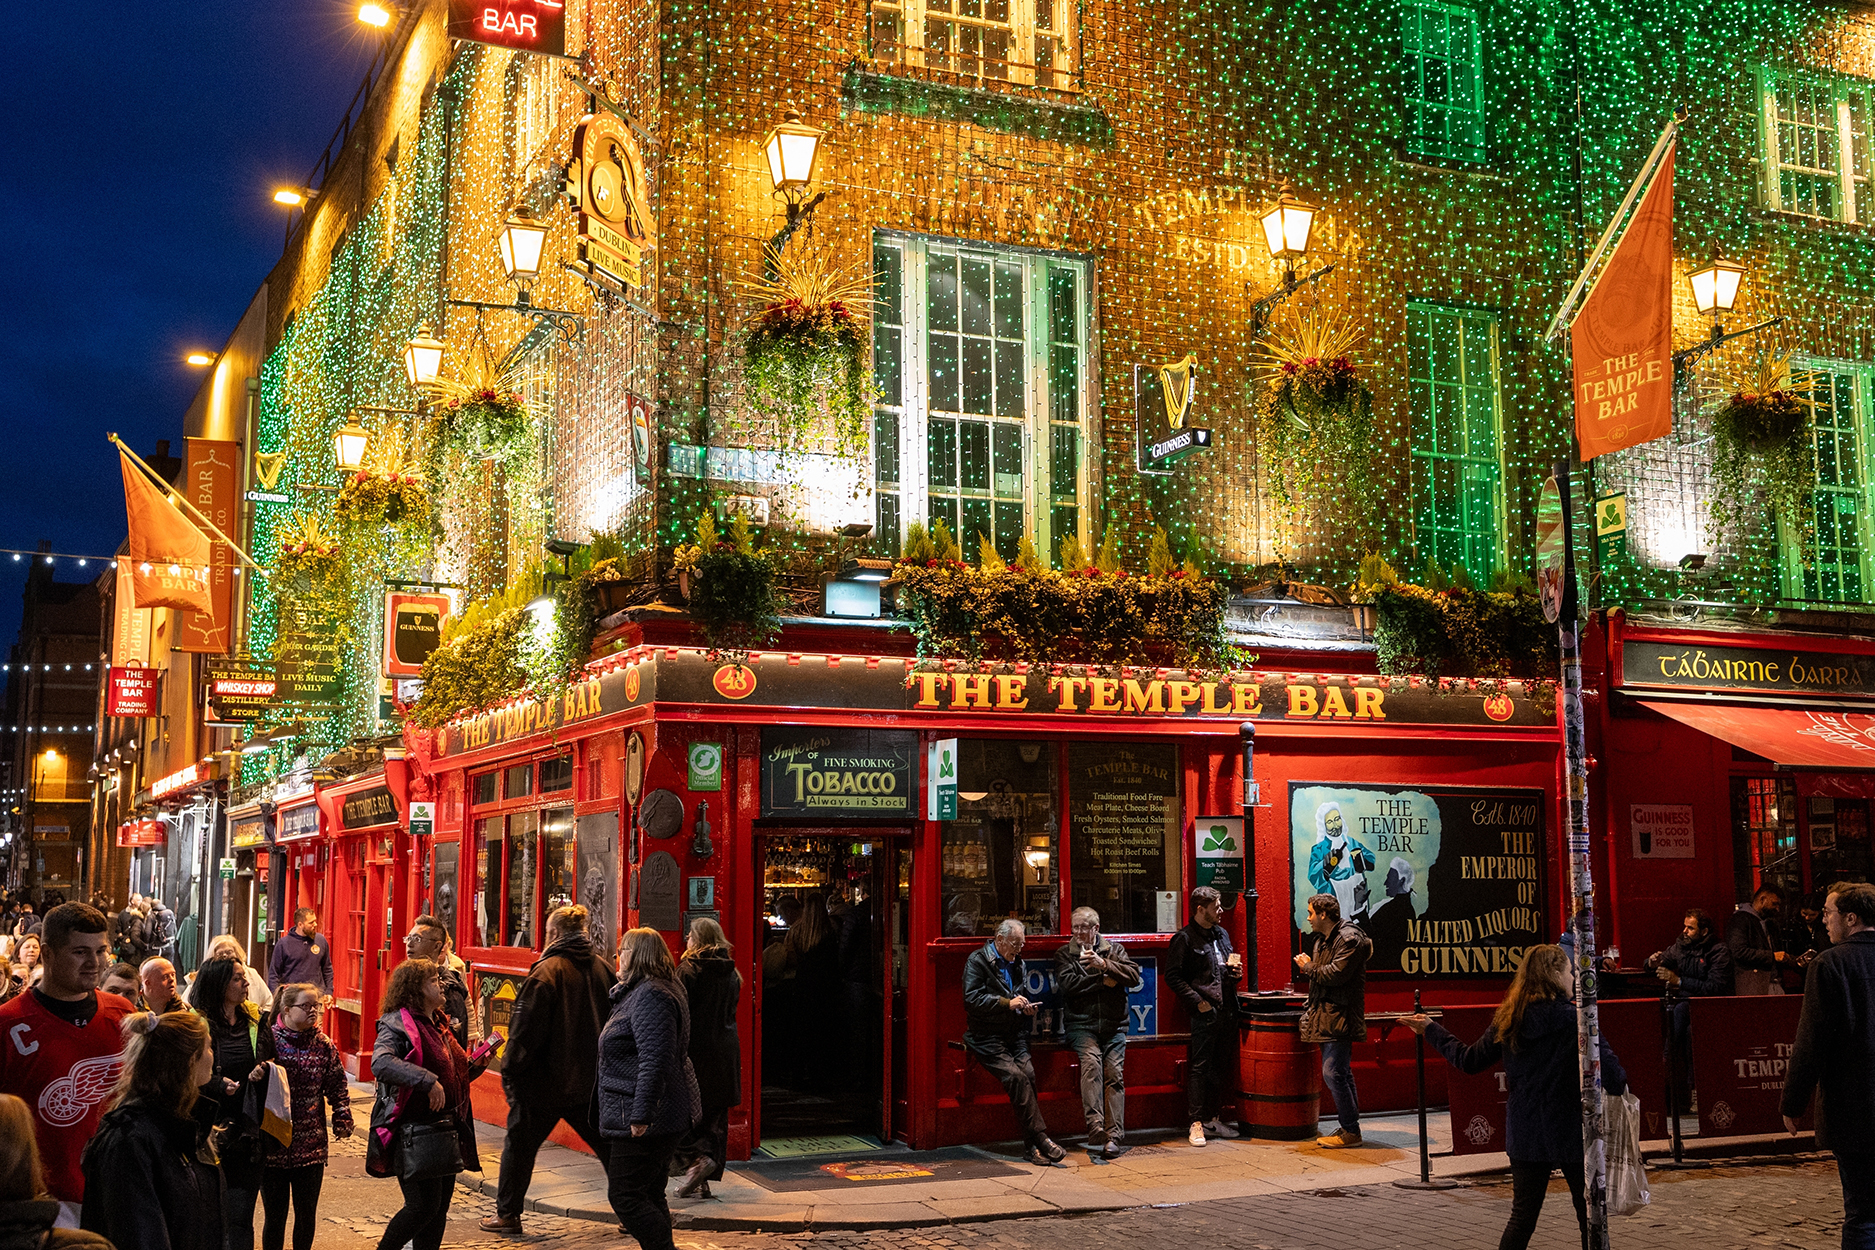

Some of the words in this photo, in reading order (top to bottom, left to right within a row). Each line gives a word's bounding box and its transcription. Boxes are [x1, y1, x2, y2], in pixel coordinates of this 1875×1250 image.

[483, 8, 537, 38] BAR
[598, 226, 631, 256] DUBLIN
[592, 246, 610, 269] LIVE
[612, 257, 637, 283] MUSIC
[1603, 353, 1639, 375] THE
[1581, 360, 1663, 404] TEMPLE
[1598, 391, 1638, 420] BAR
[1152, 432, 1191, 459] GUINNESS
[199, 470, 213, 505] BAR
[248, 490, 289, 503] GUINNESS
[217, 507, 226, 527] CO.
[161, 577, 198, 592] BAR
[400, 624, 435, 632] GUINNESS
[125, 670, 143, 678] THE
[211, 671, 228, 679] THE
[230, 672, 264, 680] TEMPLE
[282, 673, 304, 681] LIVE
[305, 674, 337, 682] MUSIC
[720, 668, 747, 691] 48
[115, 679, 153, 688] TEMPLE
[122, 688, 143, 697] BAR
[216, 682, 253, 693] WHISKEY
[254, 683, 276, 694] SHOP
[294, 684, 324, 692] DAILY
[627, 672, 638, 697] 48
[222, 696, 269, 704] DISTILLERY
[909, 672, 1029, 711] THE
[1049, 677, 1263, 718] TEMPLE
[1286, 684, 1386, 721] BAR
[463, 720, 490, 749] THE
[493, 694, 556, 741] TEMPLE
[564, 680, 602, 721] BAR
[1490, 698, 1508, 716] 48
[768, 736, 831, 763] Importers
[807, 751, 819, 760] OF
[1121, 751, 1135, 760] The
[824, 757, 847, 768] FINE
[849, 758, 896, 769] SMOKING
[1085, 762, 1139, 778] TEMPLE
[1142, 764, 1169, 780] BAR
[808, 796, 850, 807] Always
[856, 797, 867, 806] in
[871, 796, 905, 807] Stock
[1093, 792, 1128, 801] Traditional
[1130, 793, 1147, 801] Food
[1086, 803, 1104, 811] Meat
[1105, 804, 1124, 812] Plate,
[1124, 804, 1148, 812] Cheese
[1376, 799, 1412, 817] THE
[1508, 804, 1536, 826] 1840
[1633, 808, 1691, 825] GUINNESS
[1073, 815, 1092, 823] Fresh
[1093, 815, 1120, 824] Oysters,
[1122, 815, 1149, 823] Smoked
[1150, 816, 1175, 824] Salmon
[1359, 817, 1429, 835] TEMPLE
[1082, 826, 1120, 834] Charcuterie
[1655, 828, 1662, 836] IS
[1664, 828, 1689, 836] GOOD
[1092, 837, 1117, 845] Toasted
[1119, 837, 1158, 845] Sandwiches
[1377, 835, 1414, 853] BAR
[1501, 831, 1535, 854] THE
[1656, 839, 1671, 847] FOR
[1673, 839, 1690, 847] YOU
[1090, 848, 1103, 856] Hot
[1105, 848, 1123, 856] Roast
[1125, 848, 1141, 856] Beef
[1142, 848, 1159, 856] Rolls
[1460, 856, 1538, 880] EMPEROR
[1517, 881, 1536, 904] OF
[1406, 918, 1473, 944] MALTED
[1475, 906, 1541, 940] LIQUORS
[1400, 946, 1528, 974] GUINNES
[10, 1023, 39, 1056] C
[1774, 1043, 1794, 1057] TH
[1734, 1059, 1789, 1078] TEMP
